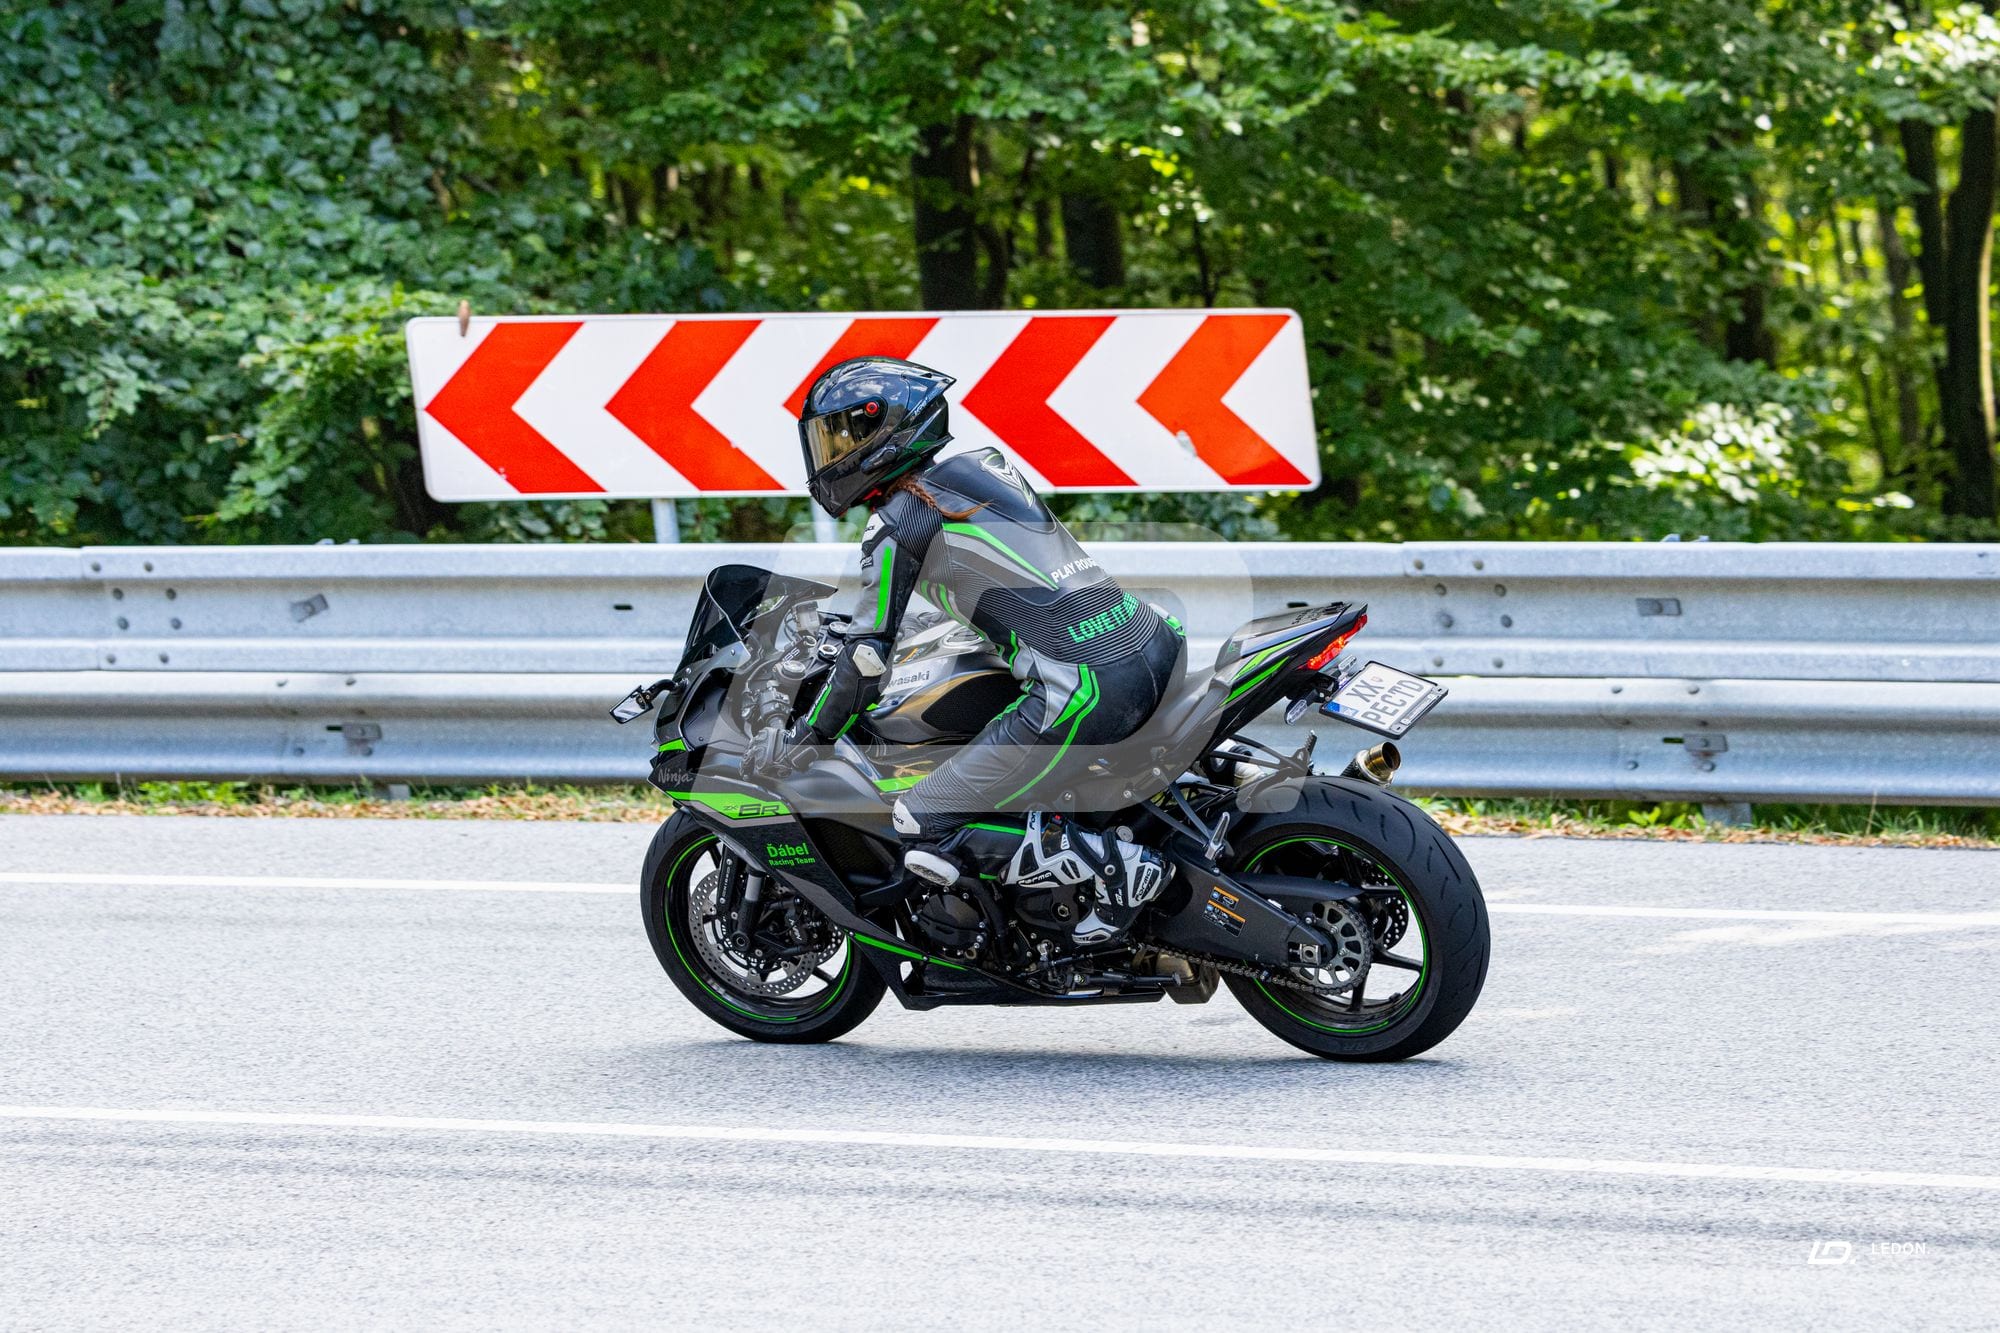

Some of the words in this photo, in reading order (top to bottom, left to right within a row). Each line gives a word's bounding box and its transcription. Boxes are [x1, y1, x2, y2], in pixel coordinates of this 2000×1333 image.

[1051, 562, 1077, 583] PLAY
[1067, 611, 1116, 643] LOVE
[1346, 680, 1385, 703] XX
[1361, 680, 1424, 725] PECTD
[657, 767, 693, 787] Ninja
[767, 842, 809, 858] Ďábel
[768, 858, 795, 867] Racing
[796, 857, 816, 865] Team
